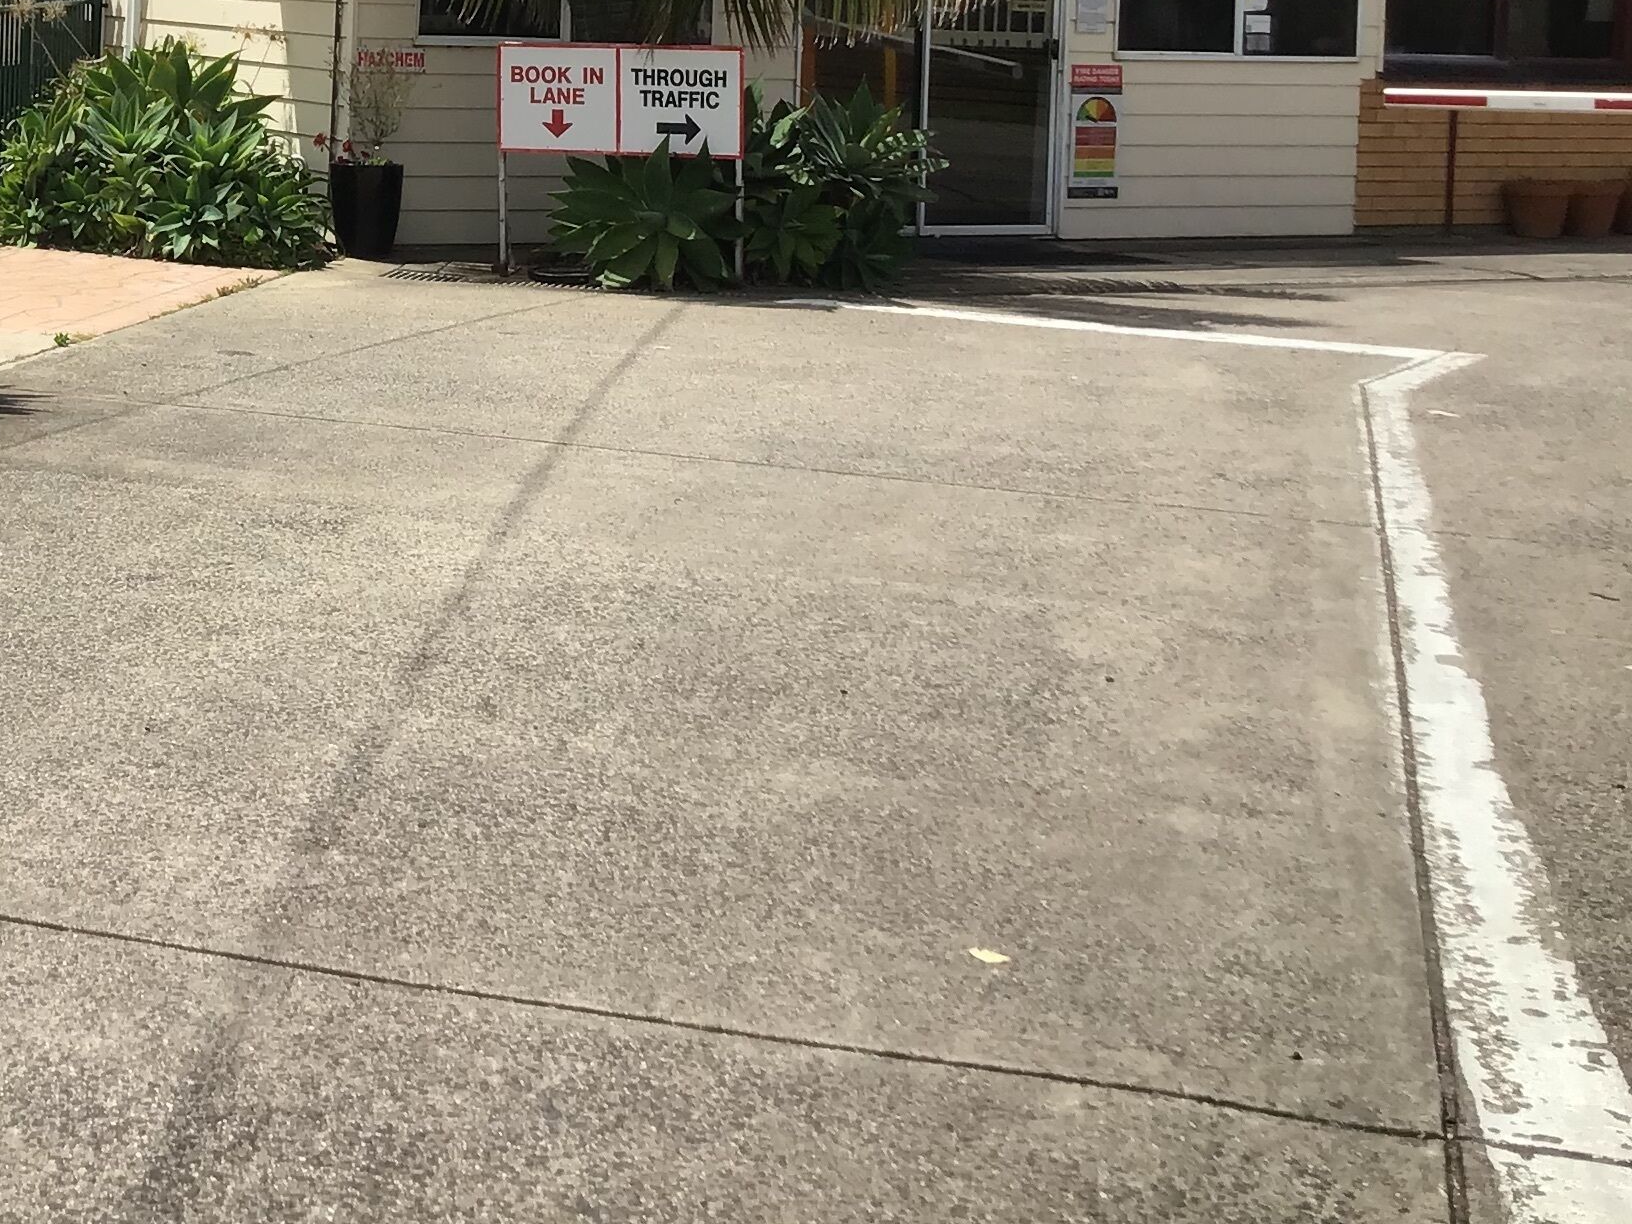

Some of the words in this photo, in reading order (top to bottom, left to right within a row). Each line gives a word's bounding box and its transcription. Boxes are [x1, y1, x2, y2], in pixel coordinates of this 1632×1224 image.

[511, 66, 572, 83] BOOK
[584, 68, 603, 84] IN
[631, 68, 727, 87] THROUGH
[531, 87, 585, 104] LANE
[640, 90, 719, 109] TRAFFIC
